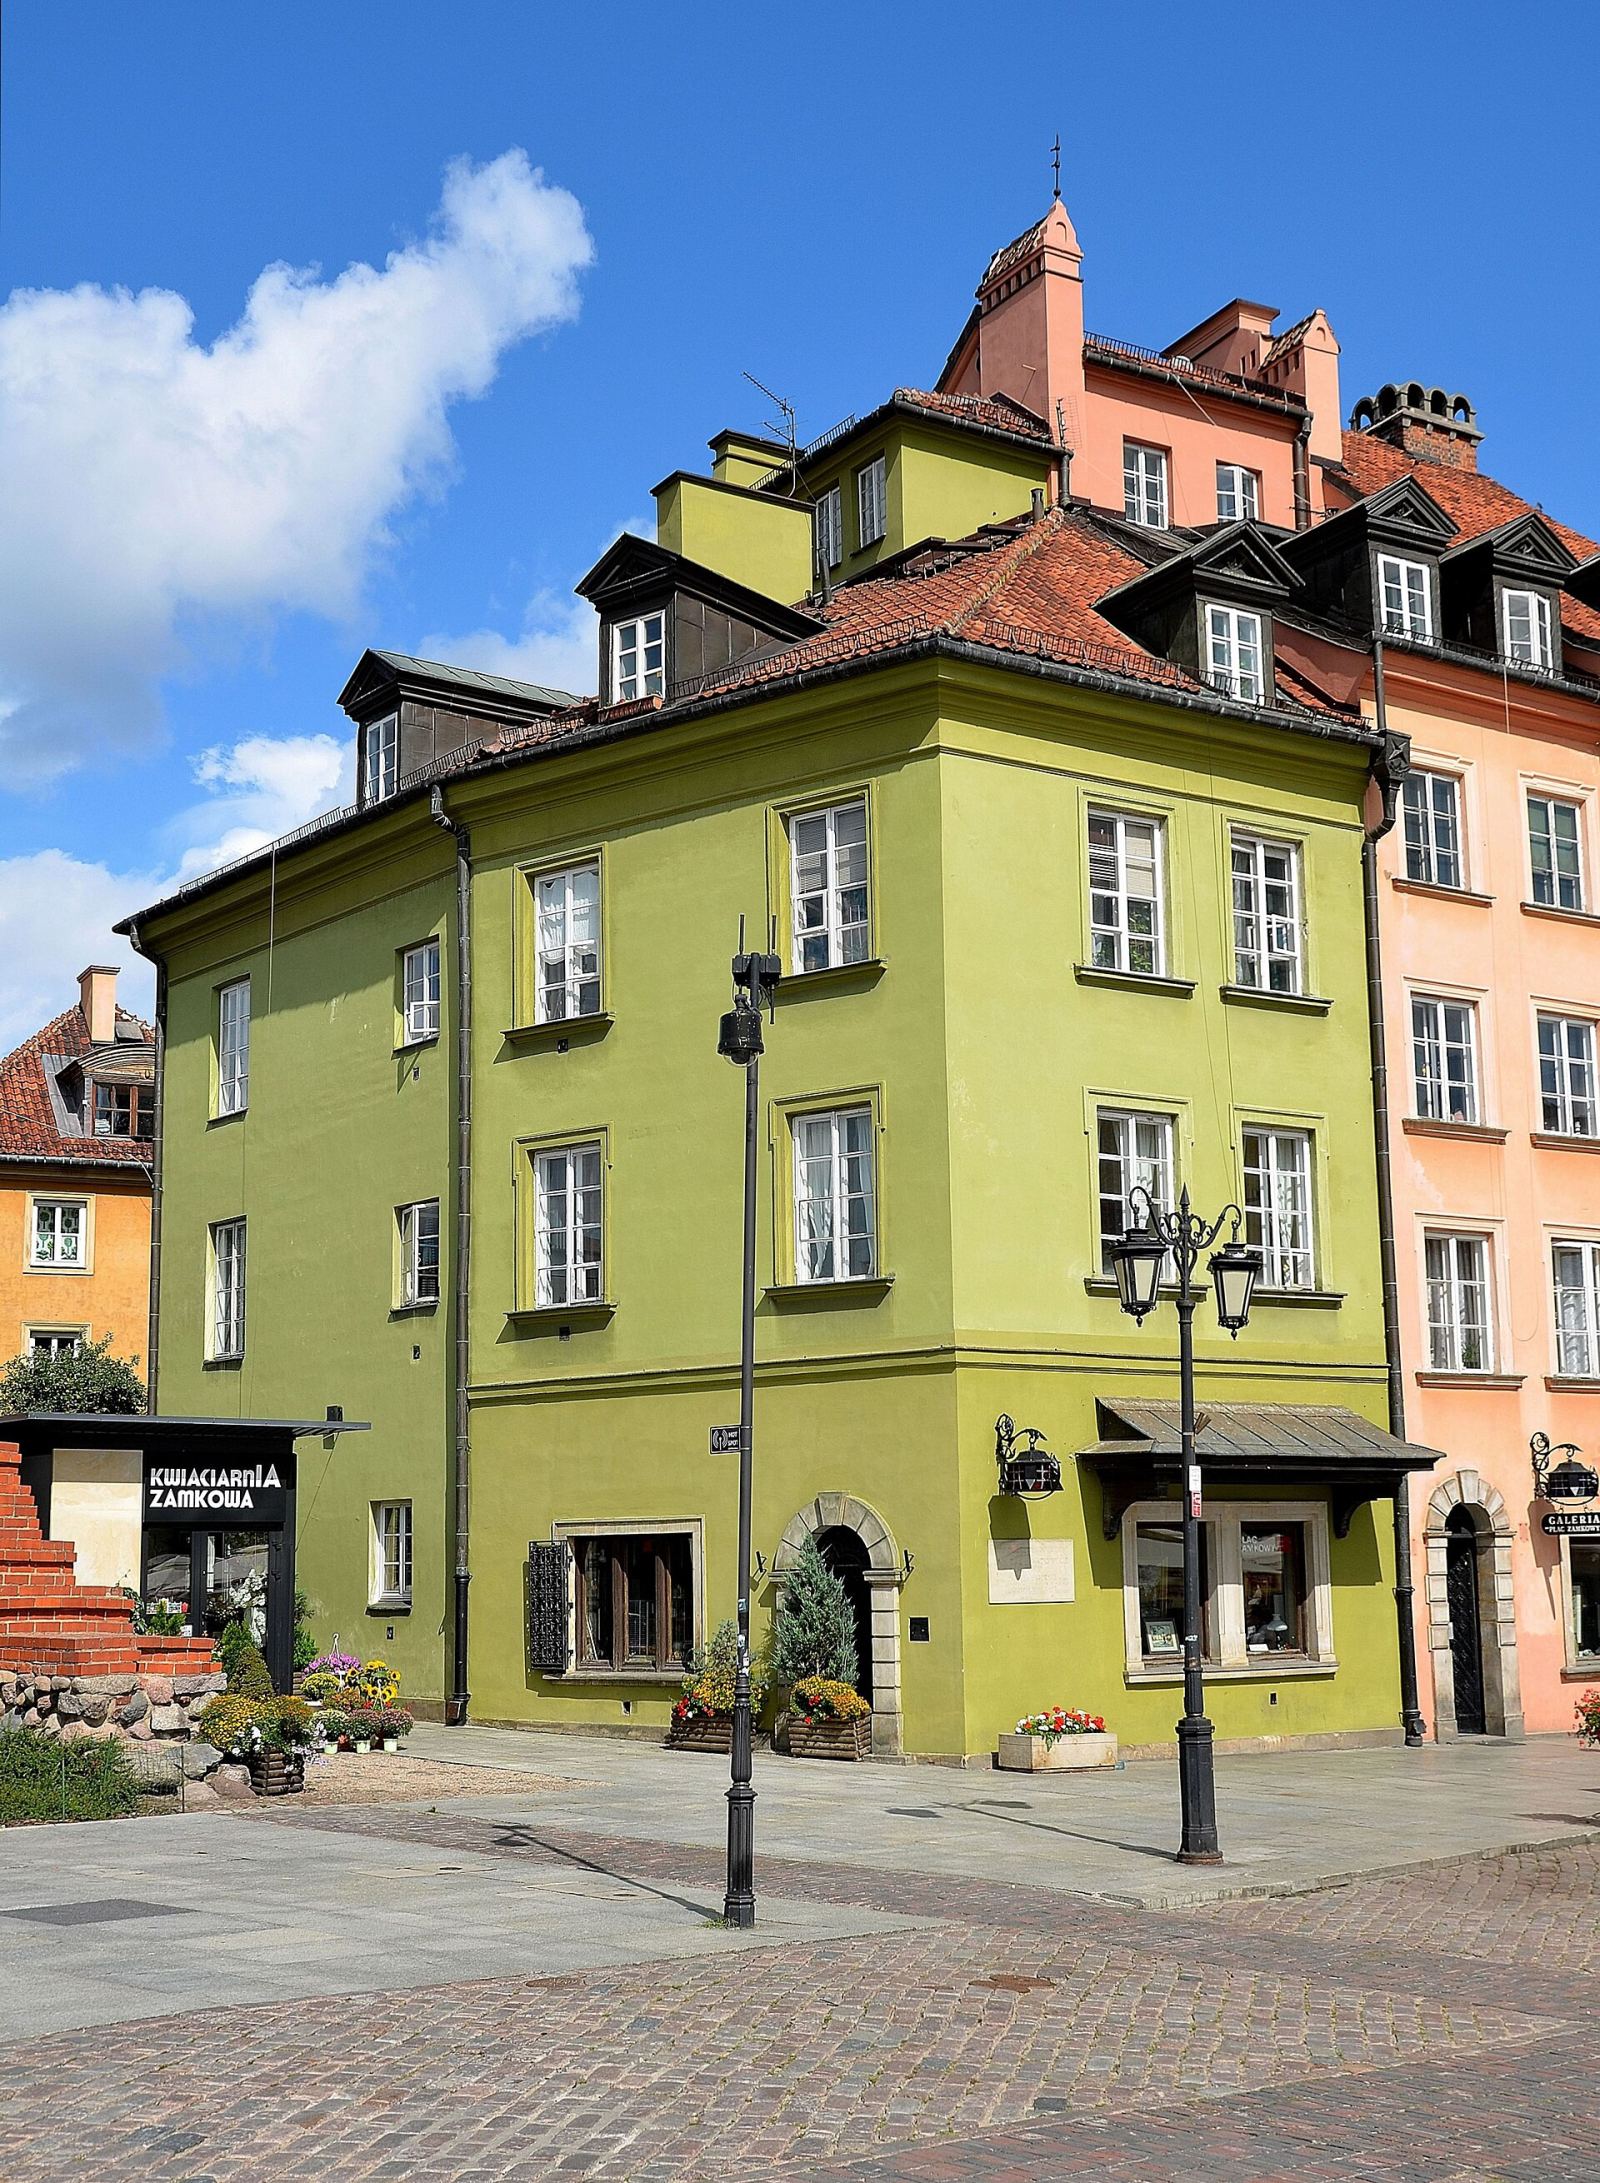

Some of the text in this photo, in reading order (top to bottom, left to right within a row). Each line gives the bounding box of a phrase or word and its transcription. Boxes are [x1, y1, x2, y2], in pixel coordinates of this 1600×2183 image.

[149, 1488, 254, 1509] ZAMKOWA
[1548, 1514, 1600, 1525] GALERIA
[1241, 1535, 1258, 1544] LAC
[1241, 1544, 1276, 1553] AMKOWY
